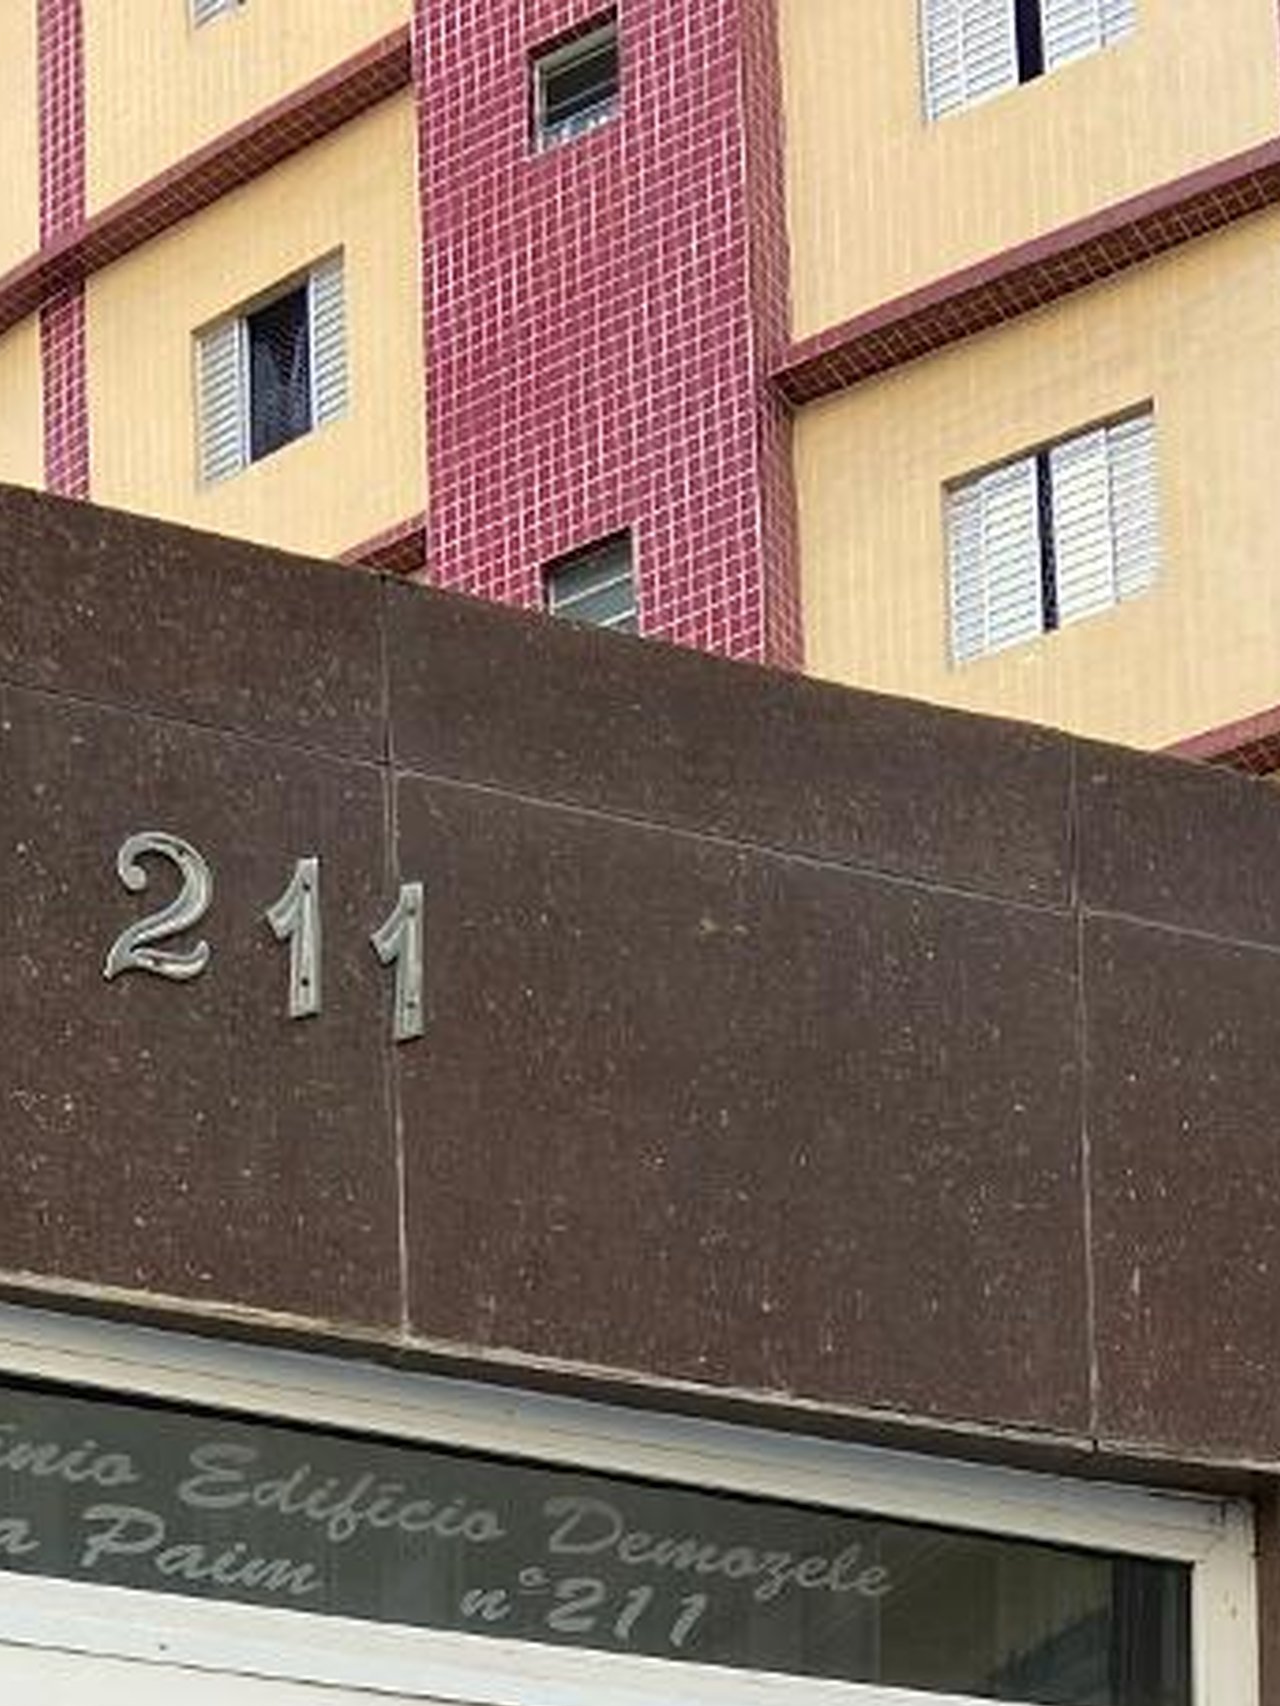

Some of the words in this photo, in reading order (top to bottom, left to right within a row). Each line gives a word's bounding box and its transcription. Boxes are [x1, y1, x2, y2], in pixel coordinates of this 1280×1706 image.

[103, 830, 423, 1043] 211
[80, 1503, 322, 1595] Paim
[177, 1443, 508, 1542] Edifício
[541, 1497, 897, 1600] Demozele
